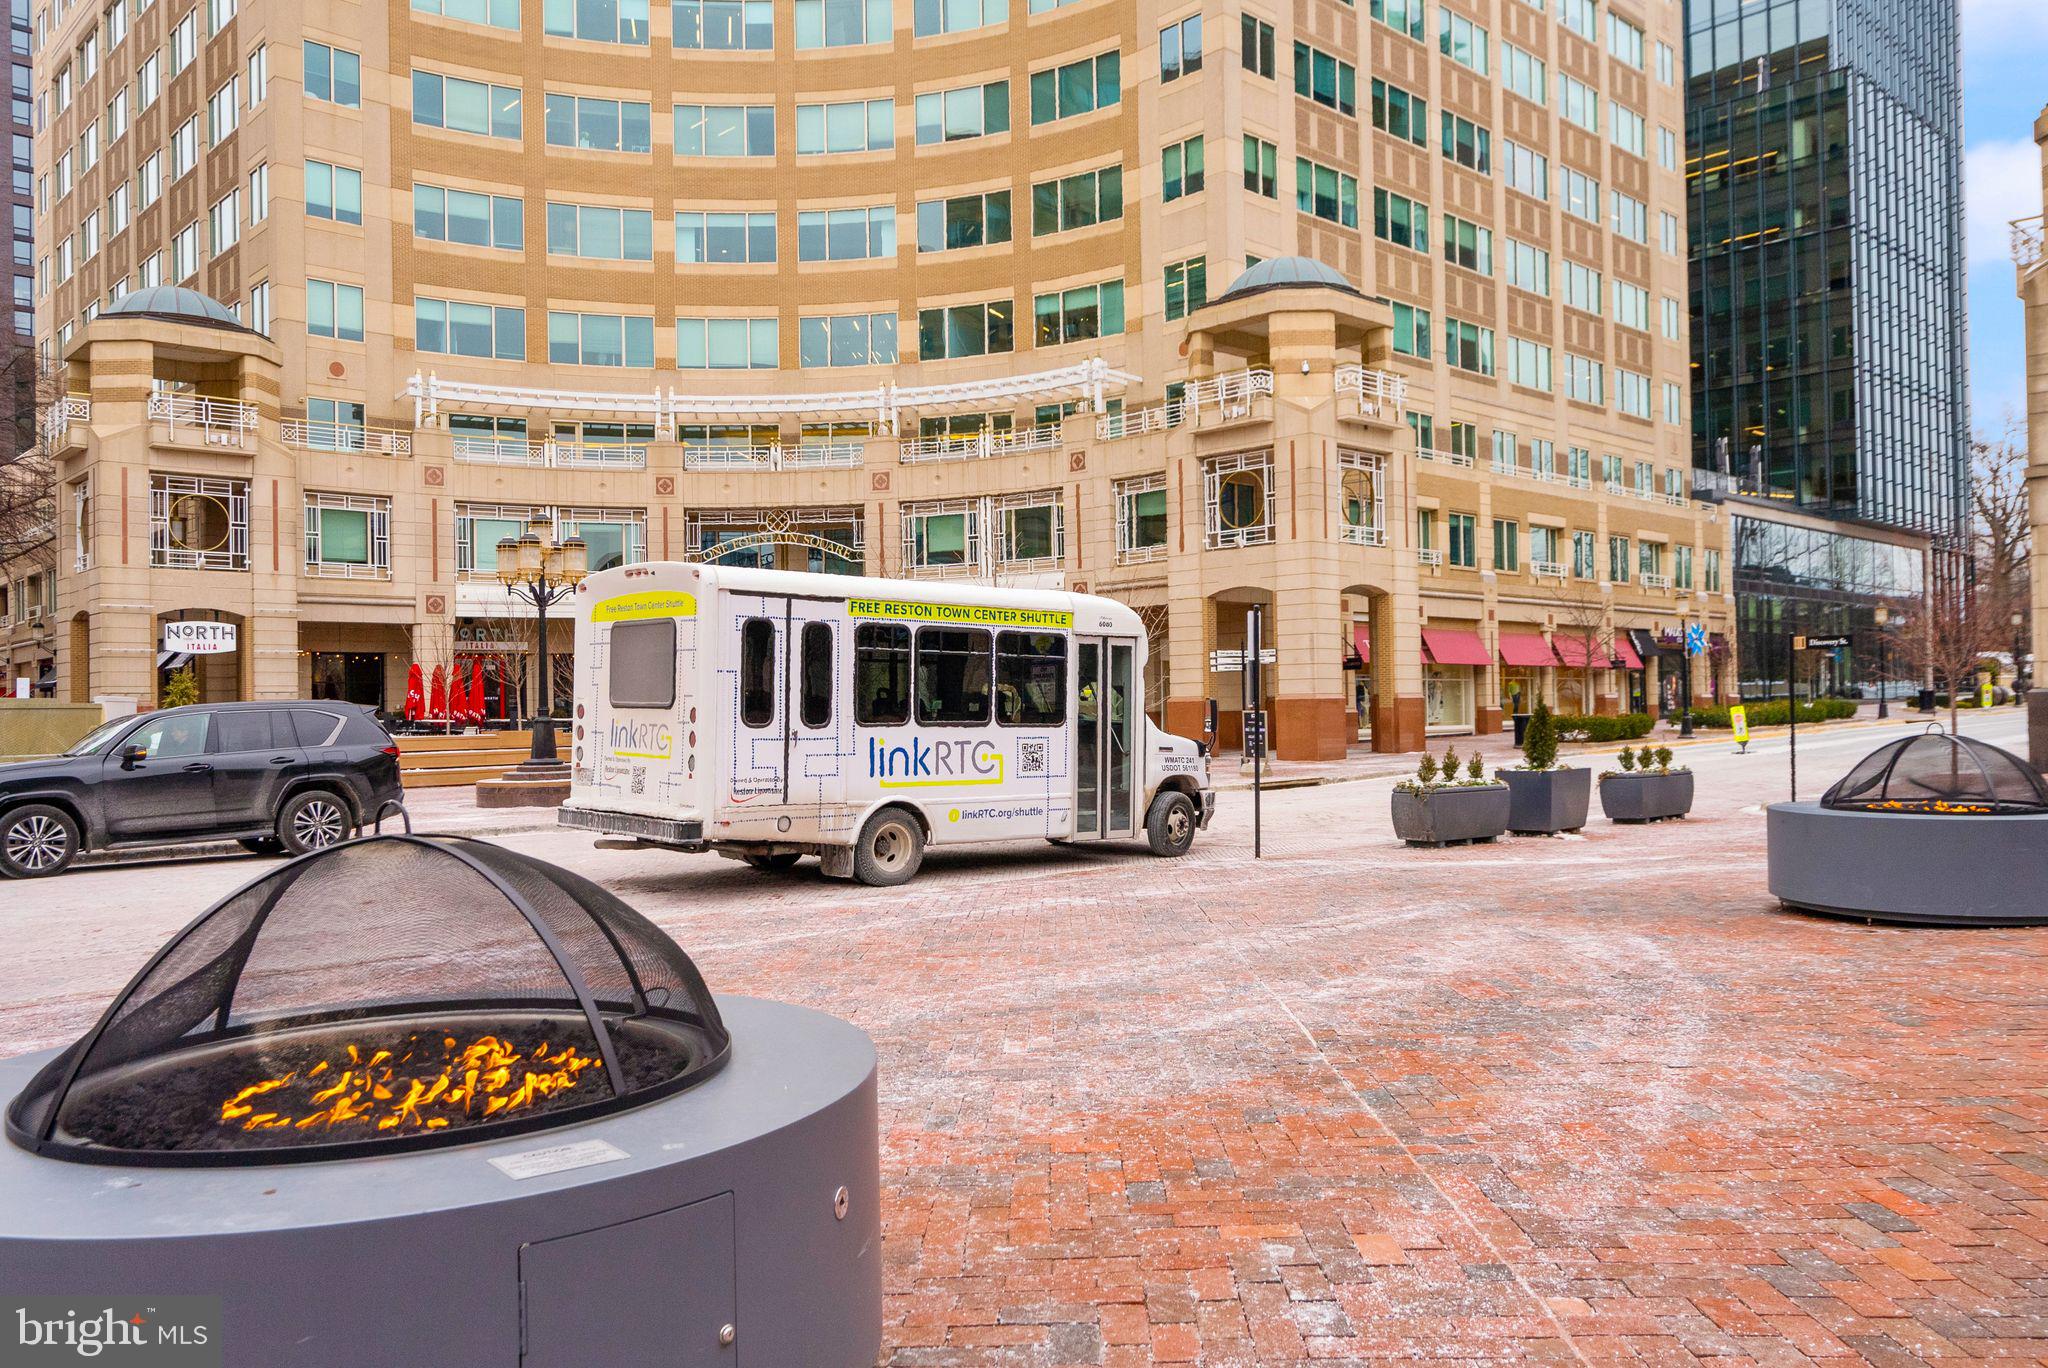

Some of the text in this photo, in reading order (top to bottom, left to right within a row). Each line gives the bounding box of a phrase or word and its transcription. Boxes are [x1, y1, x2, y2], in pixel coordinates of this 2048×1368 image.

[702, 533, 851, 561] ONE FOUNTAIN SQUARE
[605, 600, 684, 613] Free Reston Town Center Shuttle
[850, 601, 1067, 625] FREE RESTON TOWN CENTER SHUTTLE
[167, 625, 234, 640] NORTH
[186, 643, 218, 651] ITALIA
[465, 641, 495, 650] ITALIA
[1808, 638, 1839, 647] Discovery
[610, 718, 669, 751] linkRTC
[869, 736, 996, 778] linkRTC
[962, 806, 1044, 820] linkRTC.org/shuttle
